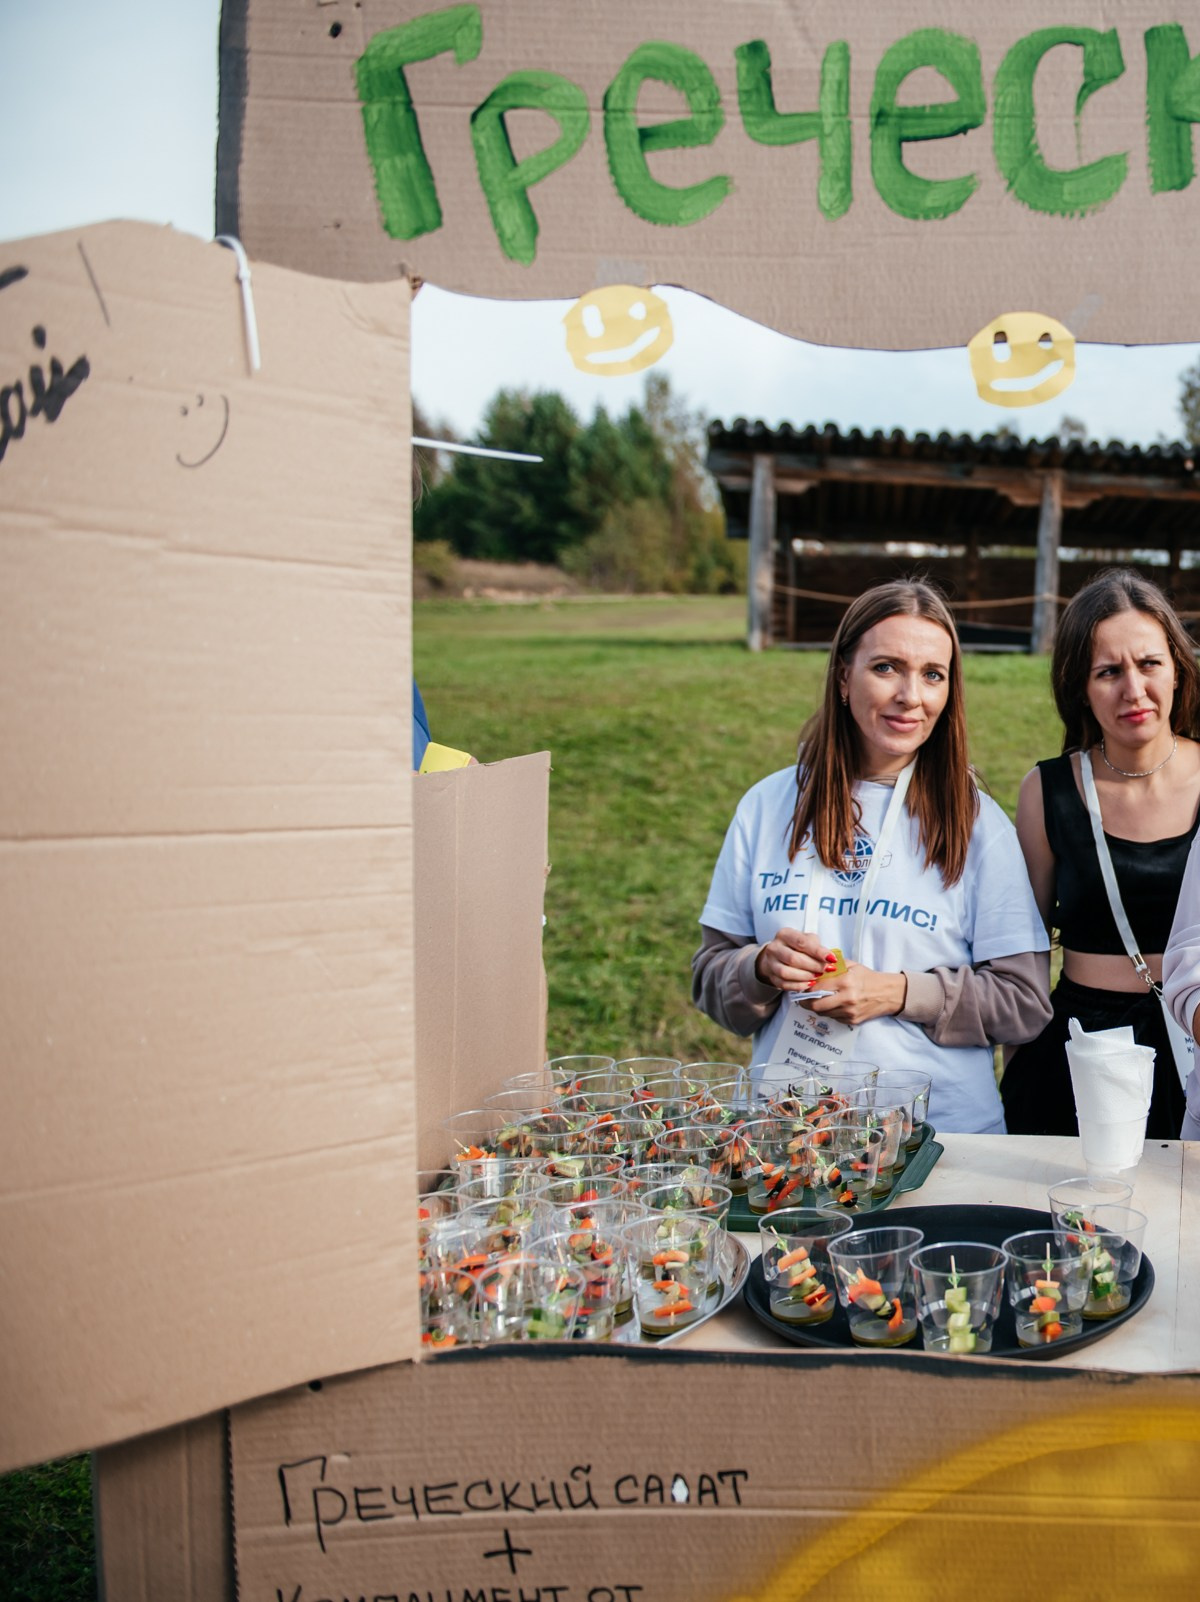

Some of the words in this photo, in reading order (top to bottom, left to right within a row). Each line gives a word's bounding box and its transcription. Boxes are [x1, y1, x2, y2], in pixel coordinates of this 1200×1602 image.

[759, 868, 790, 889] ТЫ
[793, 1020, 805, 1030] ТЫ
[793, 1030, 843, 1056] МЕГАПОЛИС!
